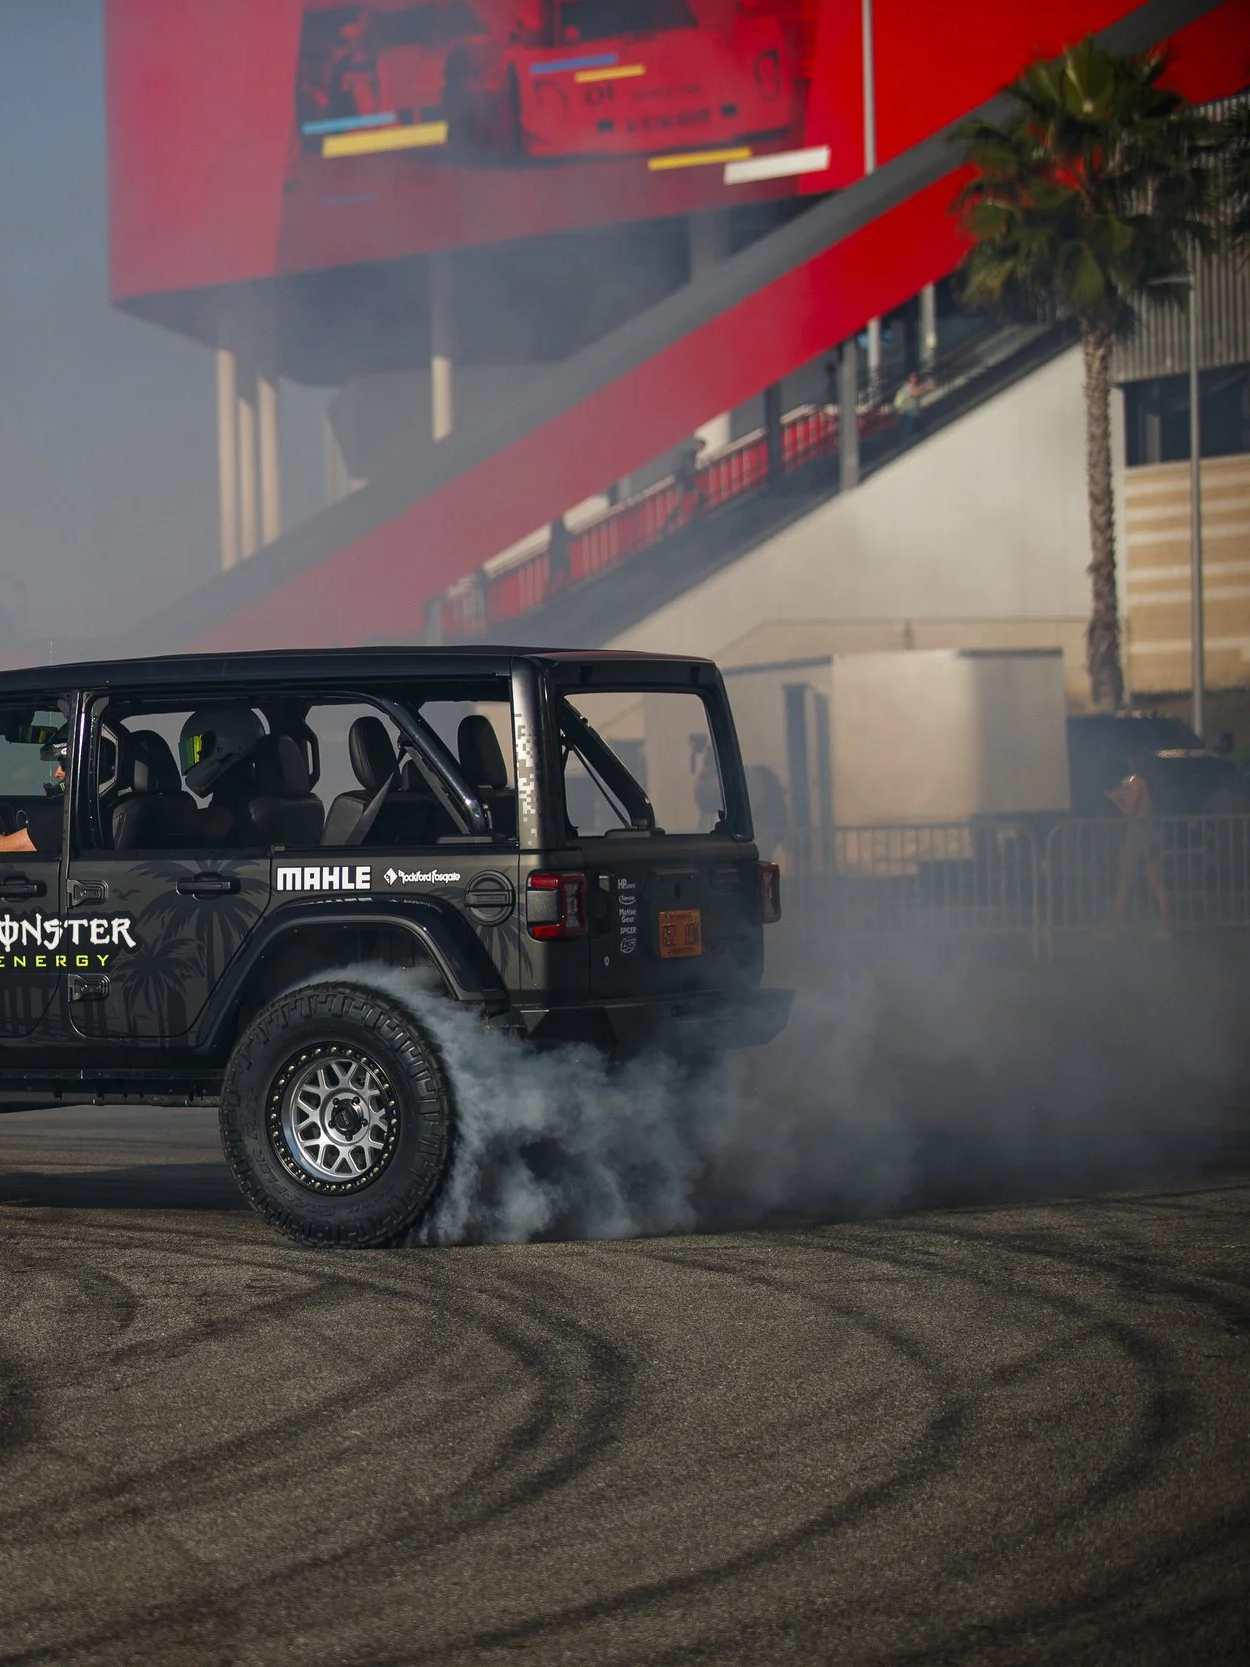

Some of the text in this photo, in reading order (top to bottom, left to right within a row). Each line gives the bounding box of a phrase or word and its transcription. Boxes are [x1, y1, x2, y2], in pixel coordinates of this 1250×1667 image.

[276, 866, 371, 891] MAHLE
[398, 869, 432, 884] Rockford
[620, 926, 637, 935] SPICER
